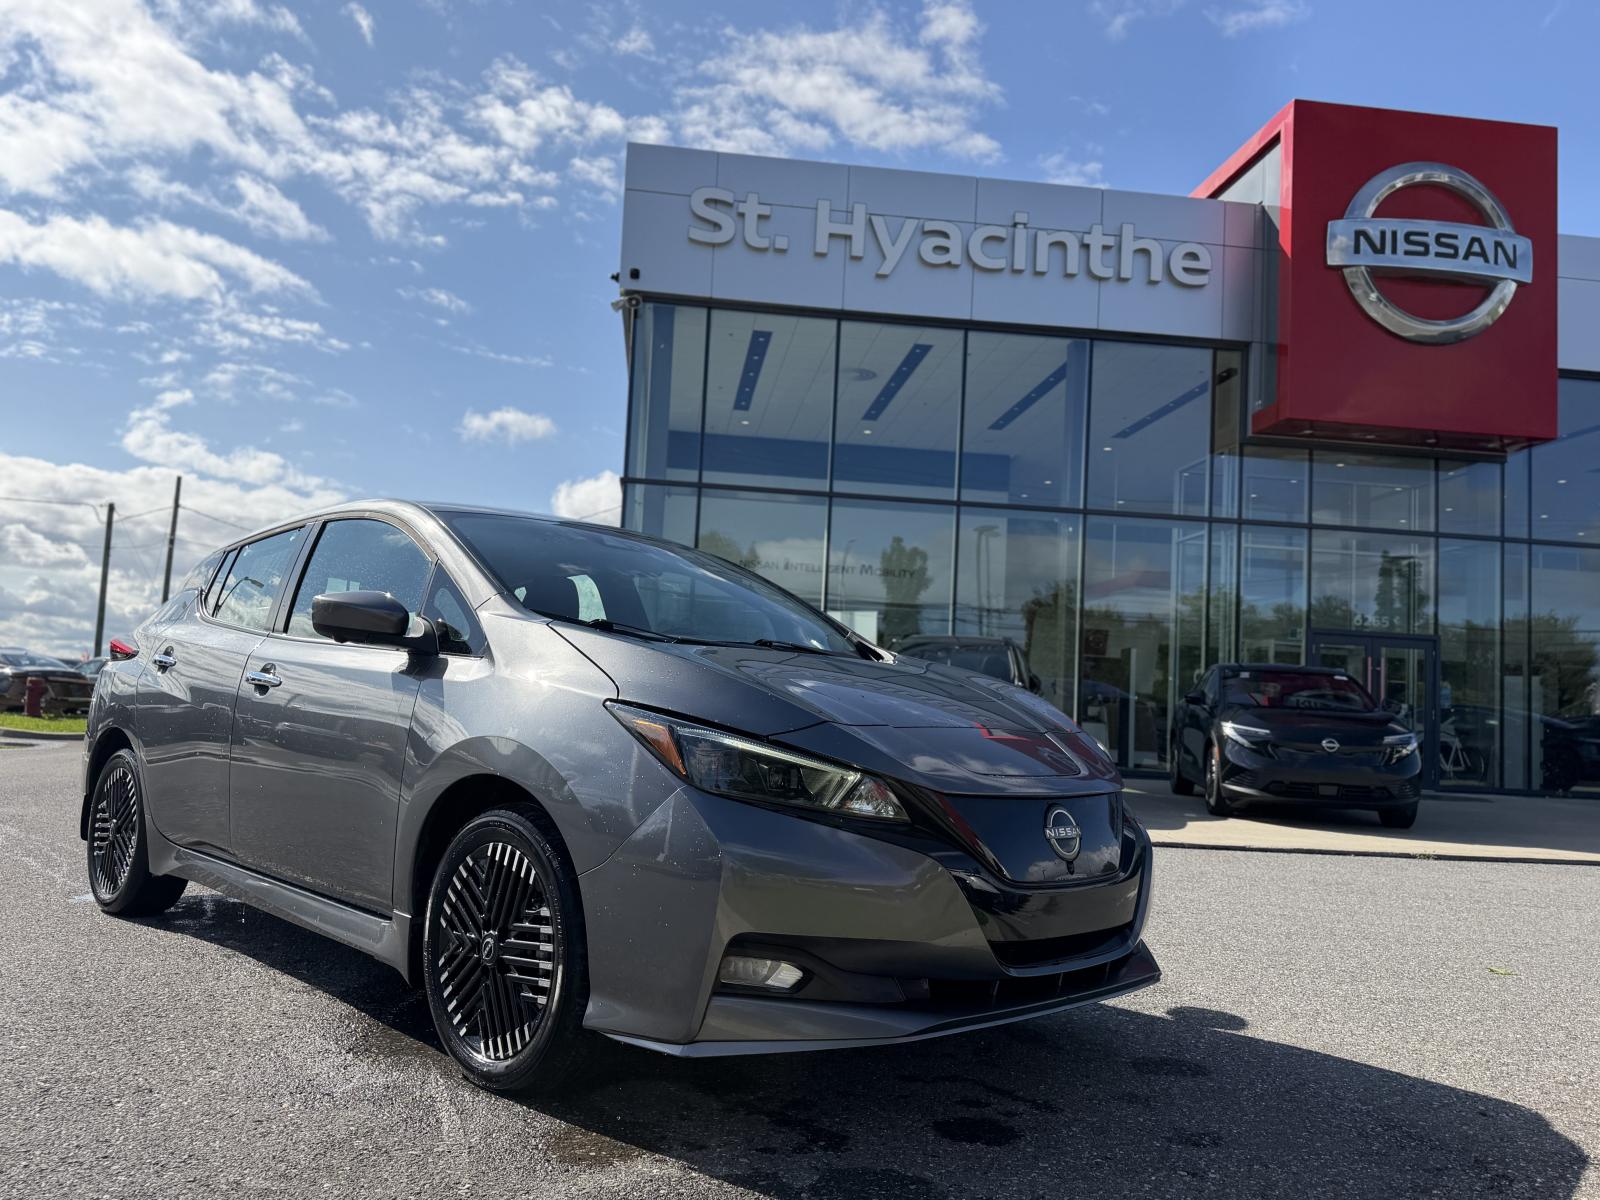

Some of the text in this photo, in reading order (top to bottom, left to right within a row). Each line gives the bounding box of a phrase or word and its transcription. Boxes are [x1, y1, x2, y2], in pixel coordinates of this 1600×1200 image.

[688, 187, 1212, 285] St. Hyacinthe
[1353, 229, 1518, 269] NISSAN
[784, 558, 856, 575] INTELLGENT
[1046, 827, 1081, 838] NISSAN
